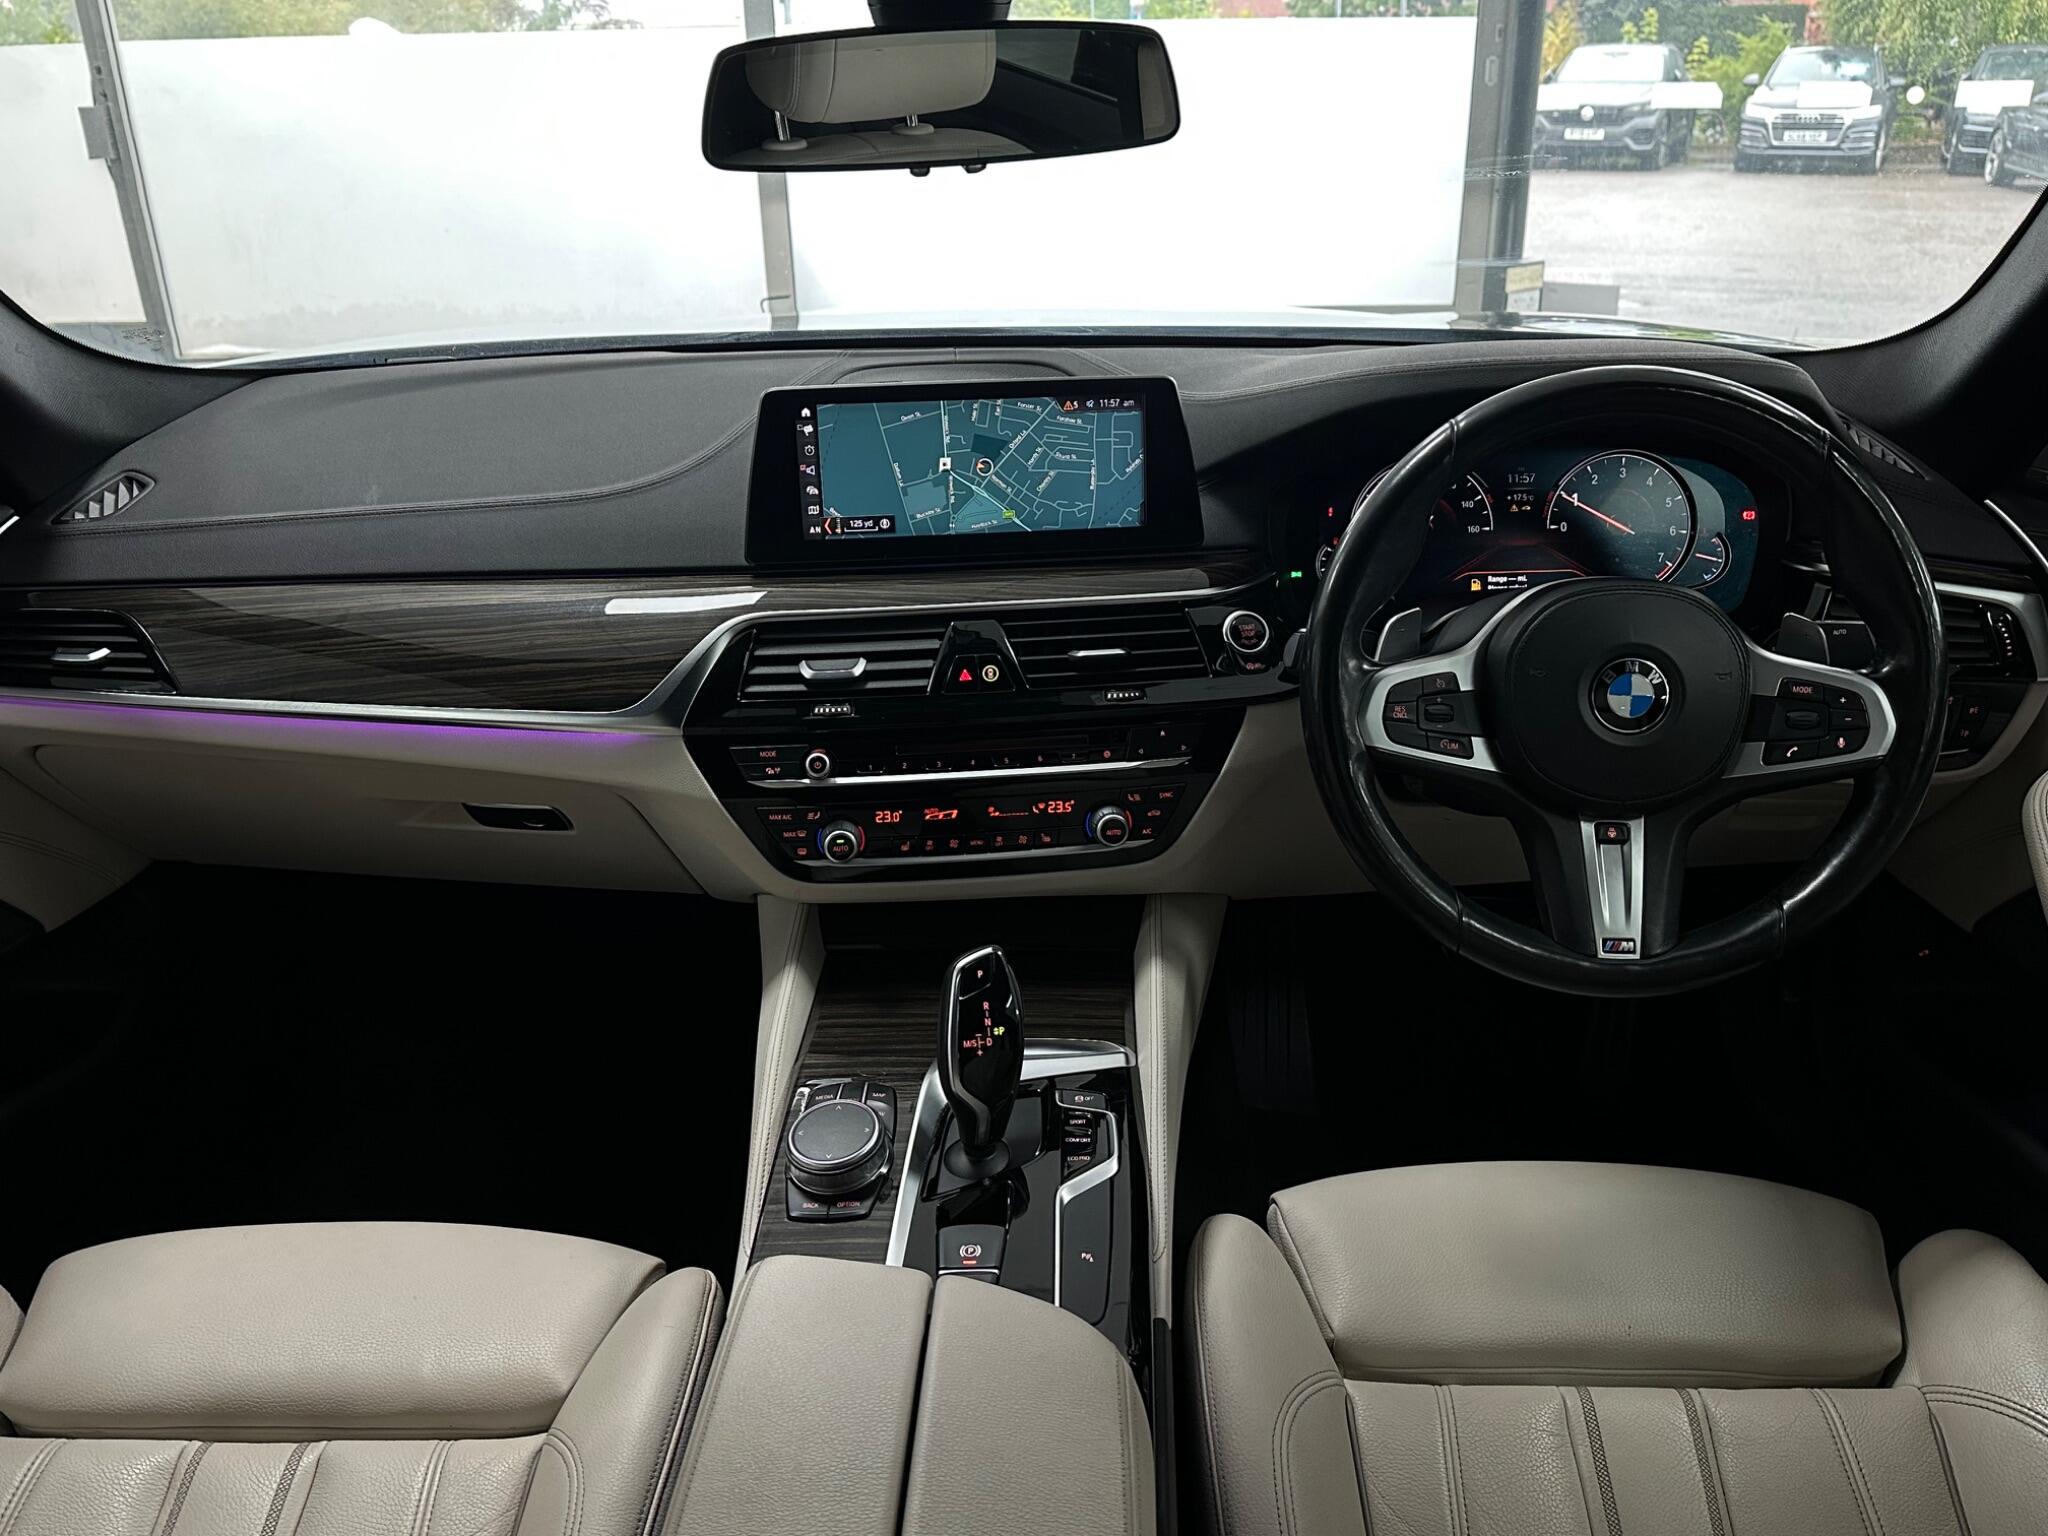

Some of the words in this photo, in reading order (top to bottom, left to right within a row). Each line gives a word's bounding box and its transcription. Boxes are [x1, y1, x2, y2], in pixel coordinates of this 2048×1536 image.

[1099, 398, 1120, 408] 11:57
[1122, 399, 1135, 407] am
[1619, 467, 1626, 478] 3
[1507, 473, 1536, 484] 11:57
[1591, 474, 1598, 485] 2
[1646, 476, 1653, 487] 4
[1461, 500, 1475, 509] 140
[1571, 492, 1579, 507] 1
[1665, 497, 1672, 508] 5
[849, 520, 863, 528] 125
[863, 519, 874, 529] yd
[1560, 521, 1568, 532] 0
[1467, 525, 1481, 534] 160
[1669, 525, 1676, 536] 6
[1657, 552, 1665, 563] 7
[1832, 628, 1847, 636] AUTO
[1601, 661, 1664, 685] BMW
[1792, 685, 1814, 694] MODE
[1158, 791, 1175, 799] SYNC
[1142, 827, 1152, 835] A/C
[832, 844, 849, 852] AUTO
[977, 970, 983, 979] P
[983, 1001, 990, 1010] R
[984, 1018, 991, 1026] N
[963, 1038, 977, 1048] M/S
[986, 1037, 993, 1046] D
[815, 1093, 834, 1101] MEDIA
